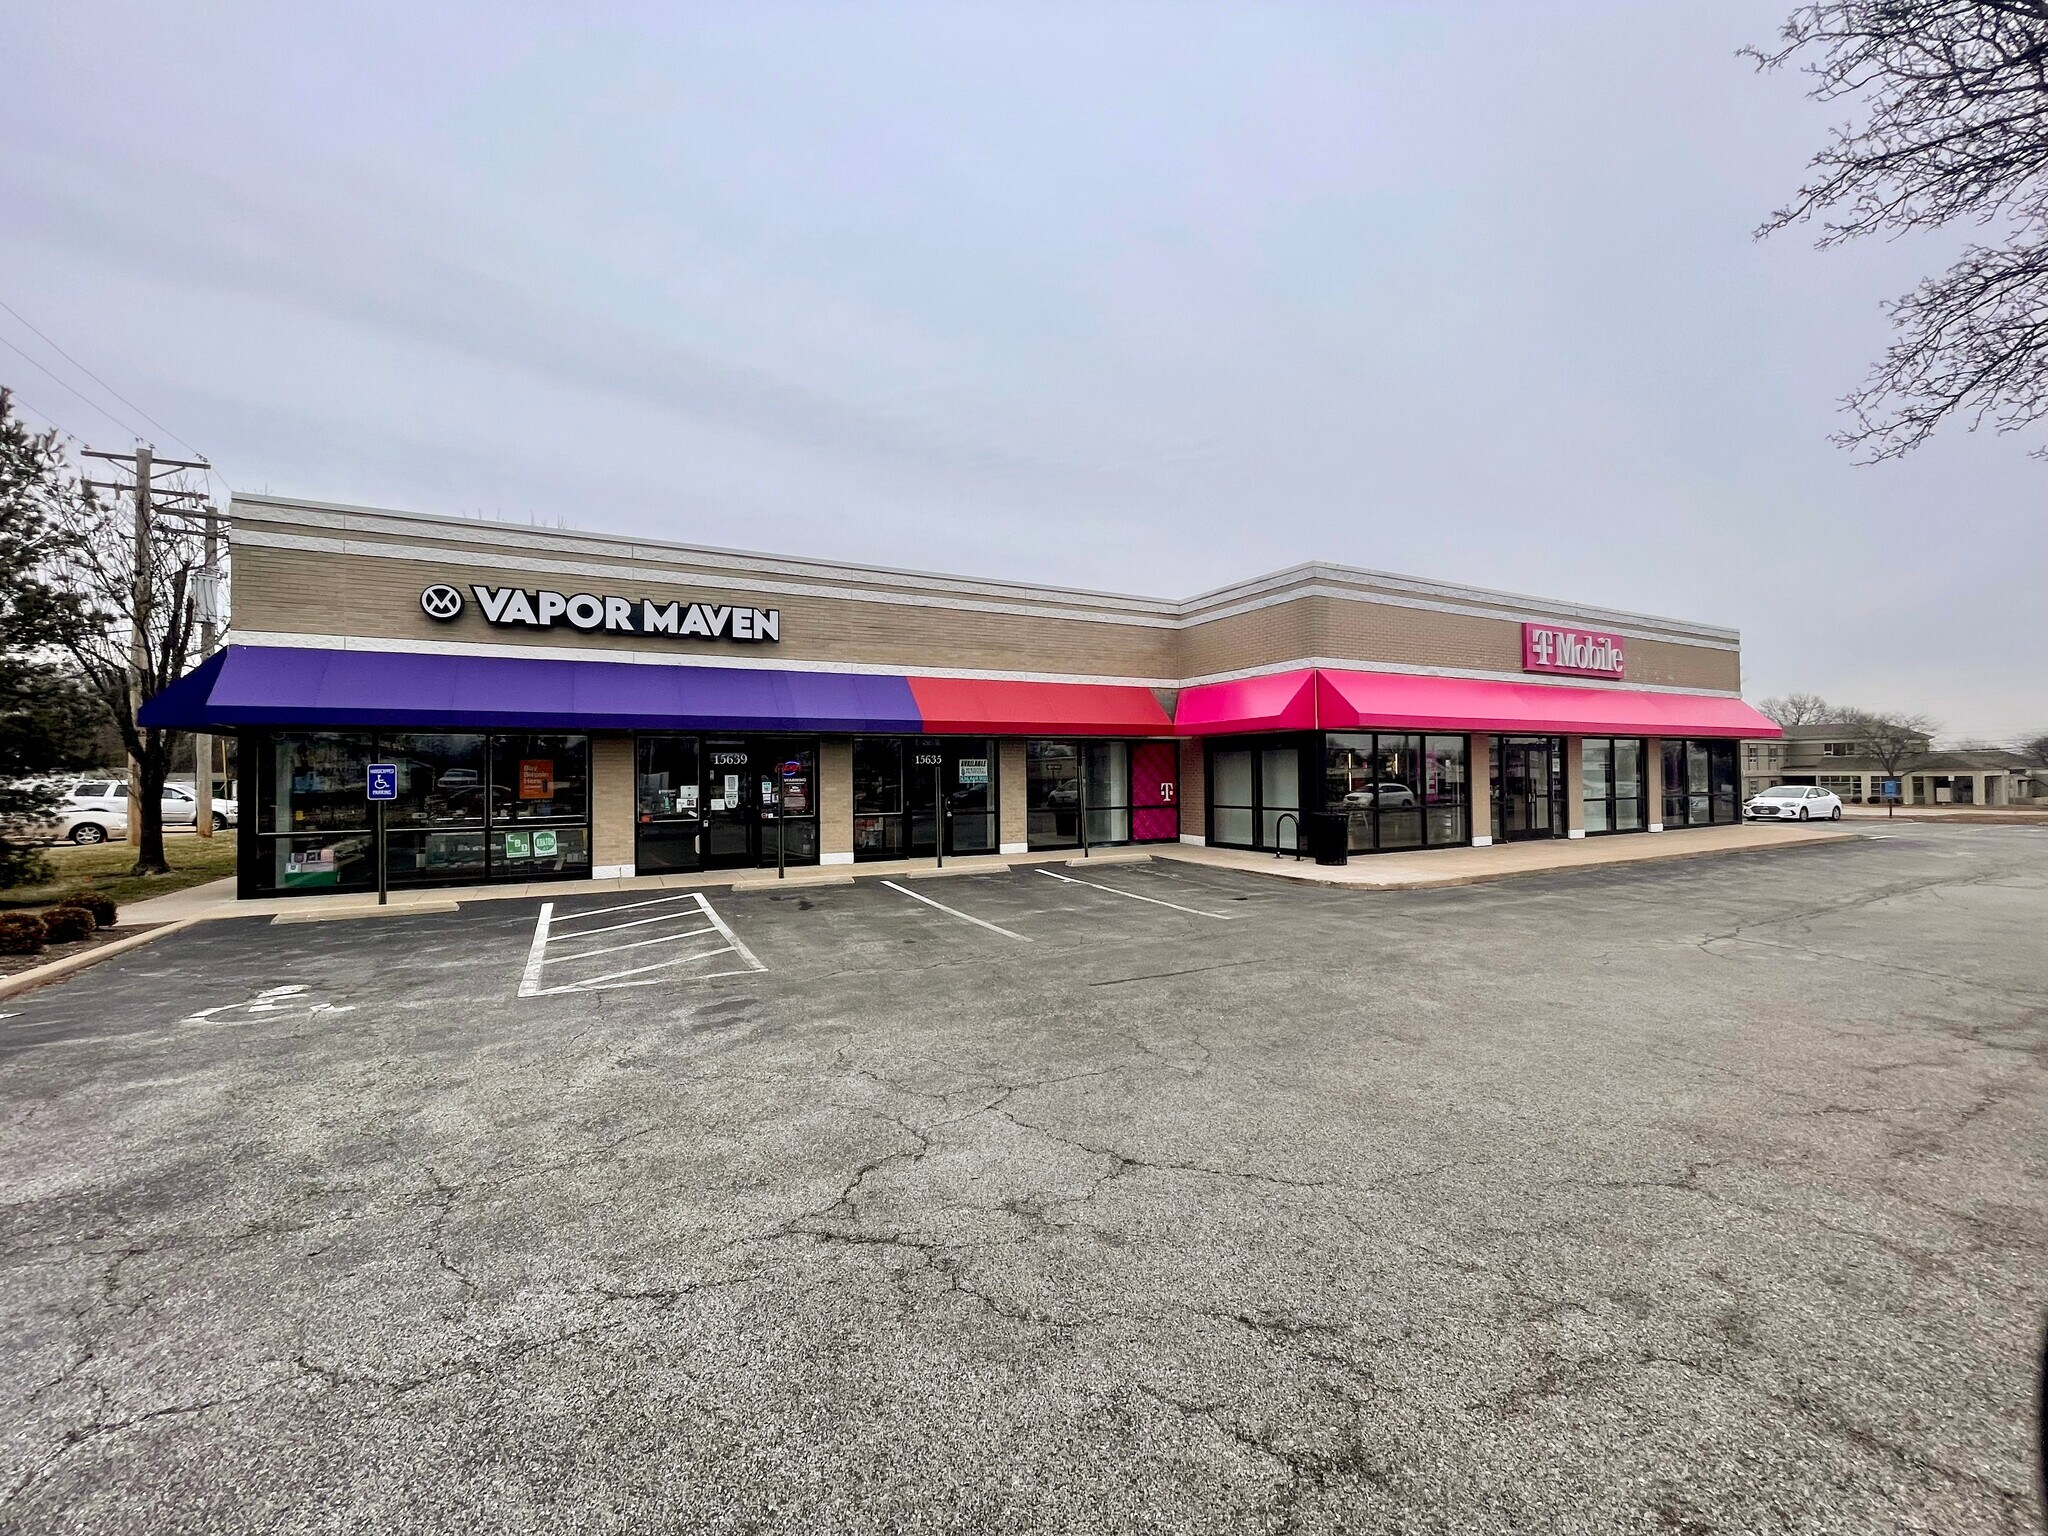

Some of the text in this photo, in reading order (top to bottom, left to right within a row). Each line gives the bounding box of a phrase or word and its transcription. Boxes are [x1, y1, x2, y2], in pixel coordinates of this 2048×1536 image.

[473, 586, 779, 641] VAPOR MAVEN
[713, 753, 748, 765] 15639
[915, 754, 942, 765] 15635
[507, 834, 528, 851] CBD
[536, 837, 555, 847] KRATOM
